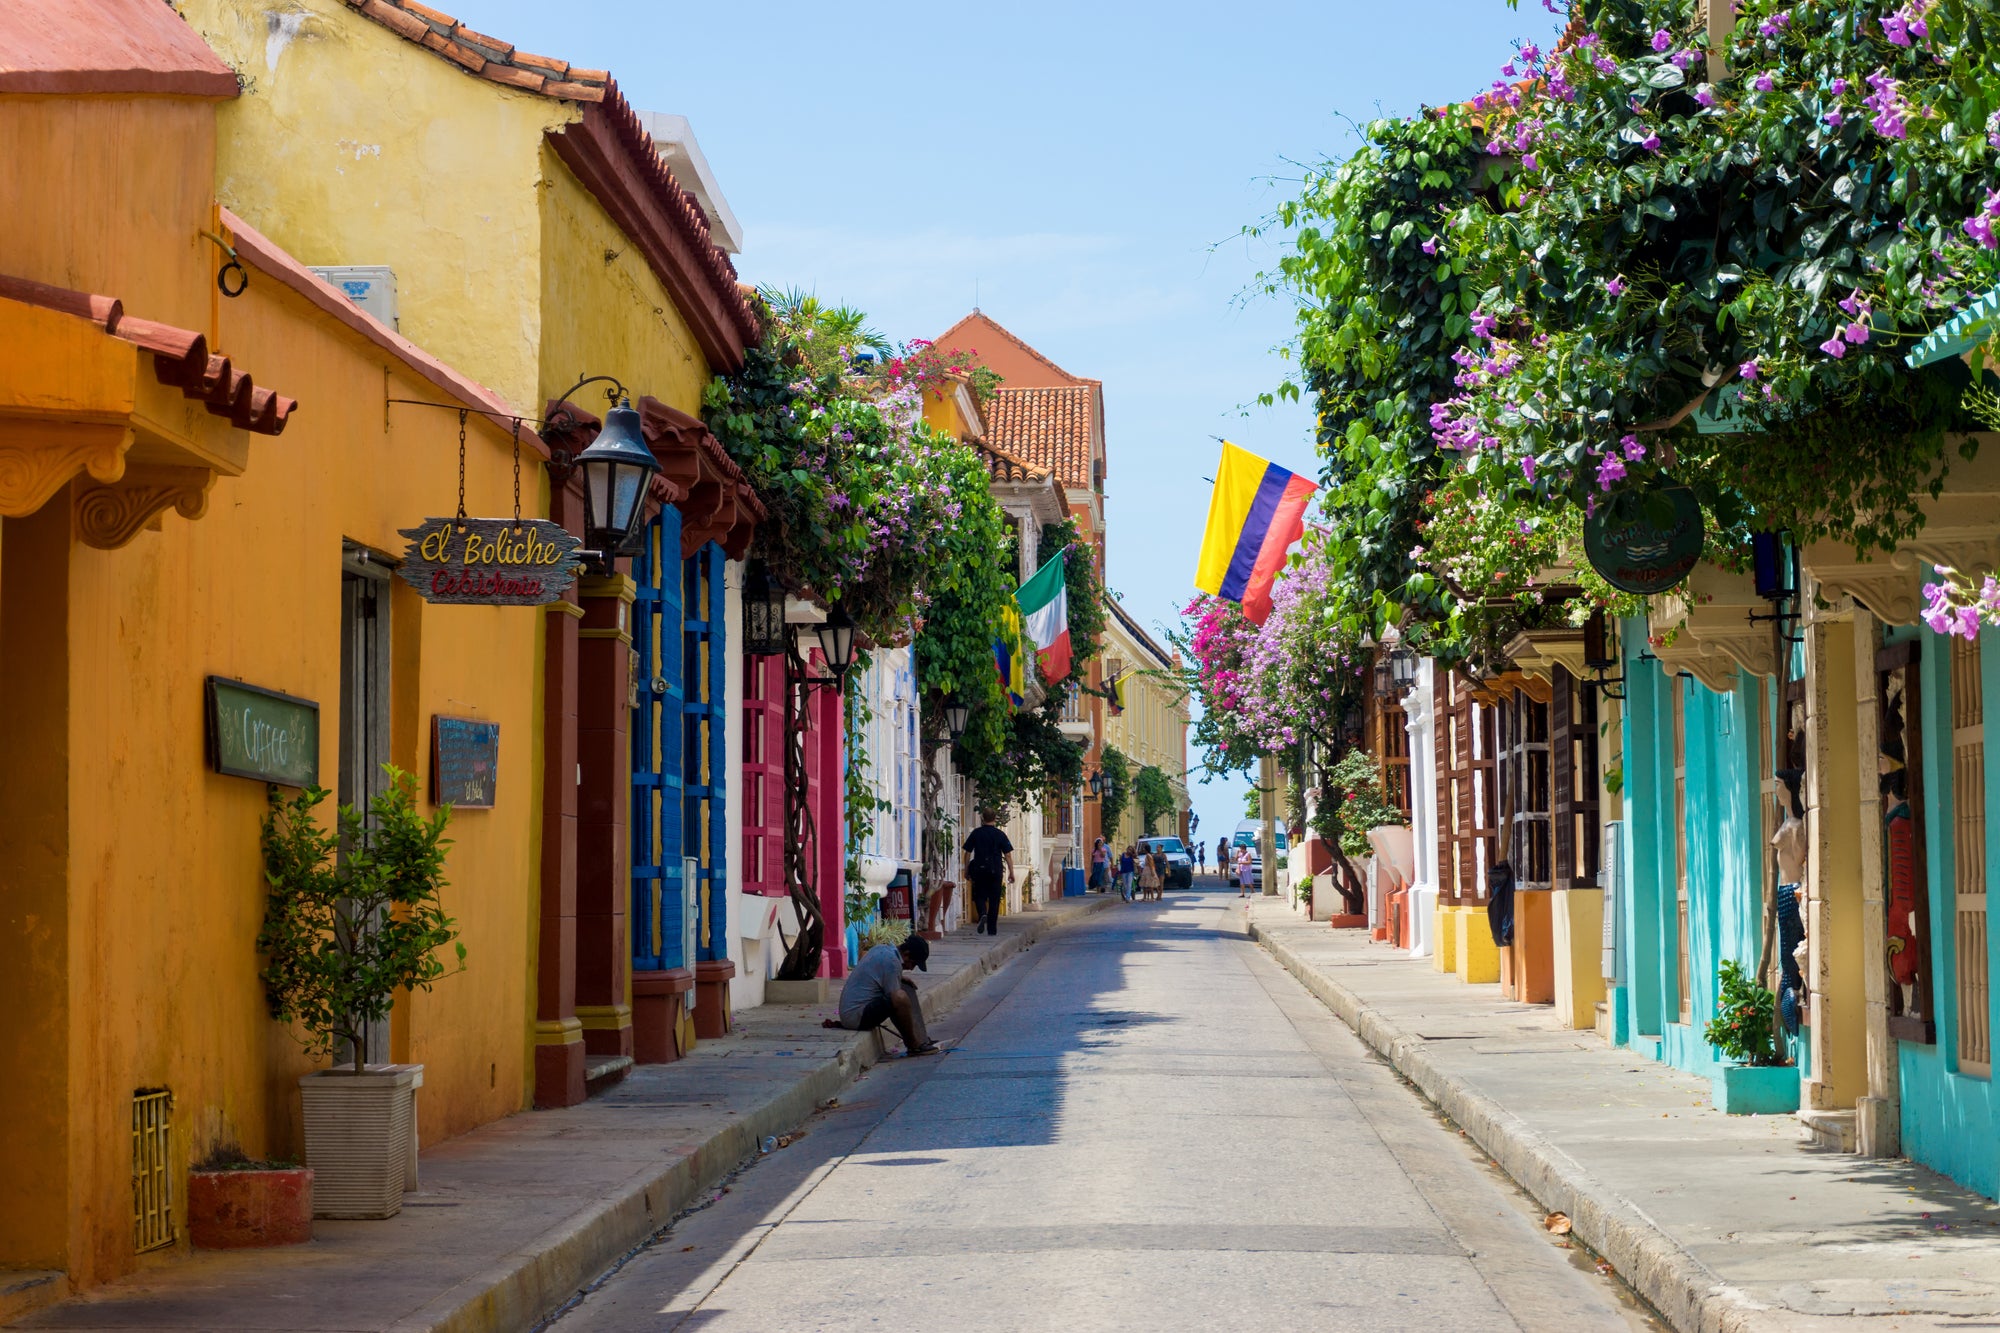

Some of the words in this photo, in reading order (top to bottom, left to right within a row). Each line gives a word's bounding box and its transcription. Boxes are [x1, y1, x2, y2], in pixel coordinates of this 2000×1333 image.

[421, 523, 452, 563] El
[463, 527, 563, 565] Boliche
[431, 568, 545, 596] Cebicheria
[243, 707, 288, 773] Coffee
